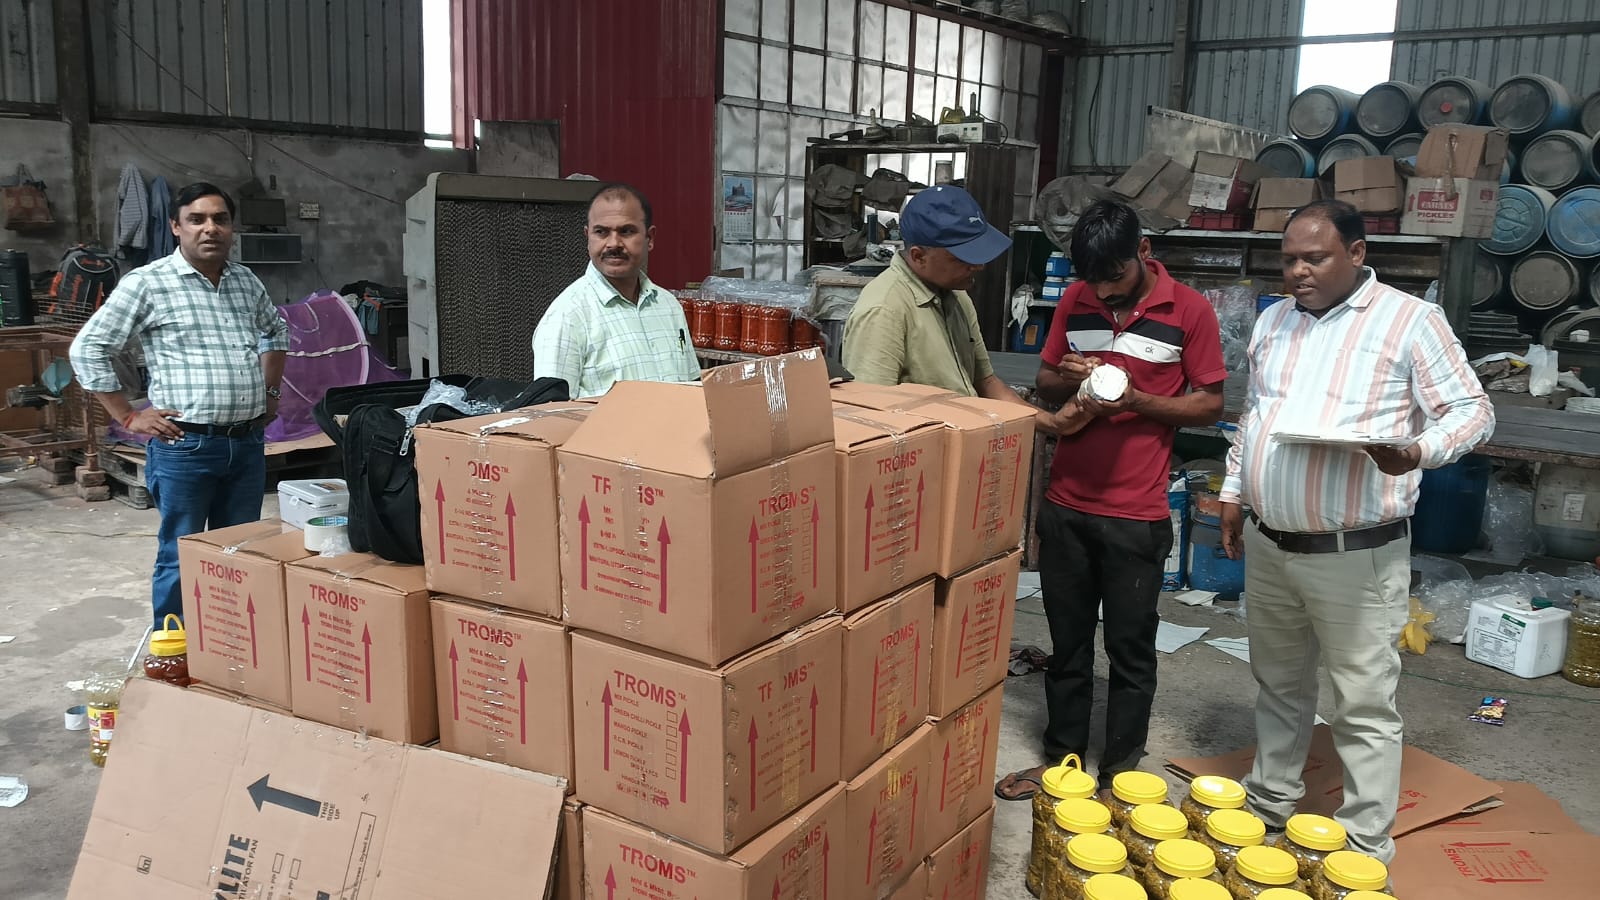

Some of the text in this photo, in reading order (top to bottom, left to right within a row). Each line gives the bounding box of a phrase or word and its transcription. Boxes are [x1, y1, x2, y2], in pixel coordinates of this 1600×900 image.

[622, 695, 640, 708] PICKLE
[646, 718, 662, 731] PICKLE
[631, 726, 648, 738] PICKLE
[628, 740, 644, 751] PICKLE
[320, 802, 329, 818] THIS
[327, 804, 336, 821] SIDE
[334, 808, 340, 820] UP
[249, 839, 258, 858] FAN
